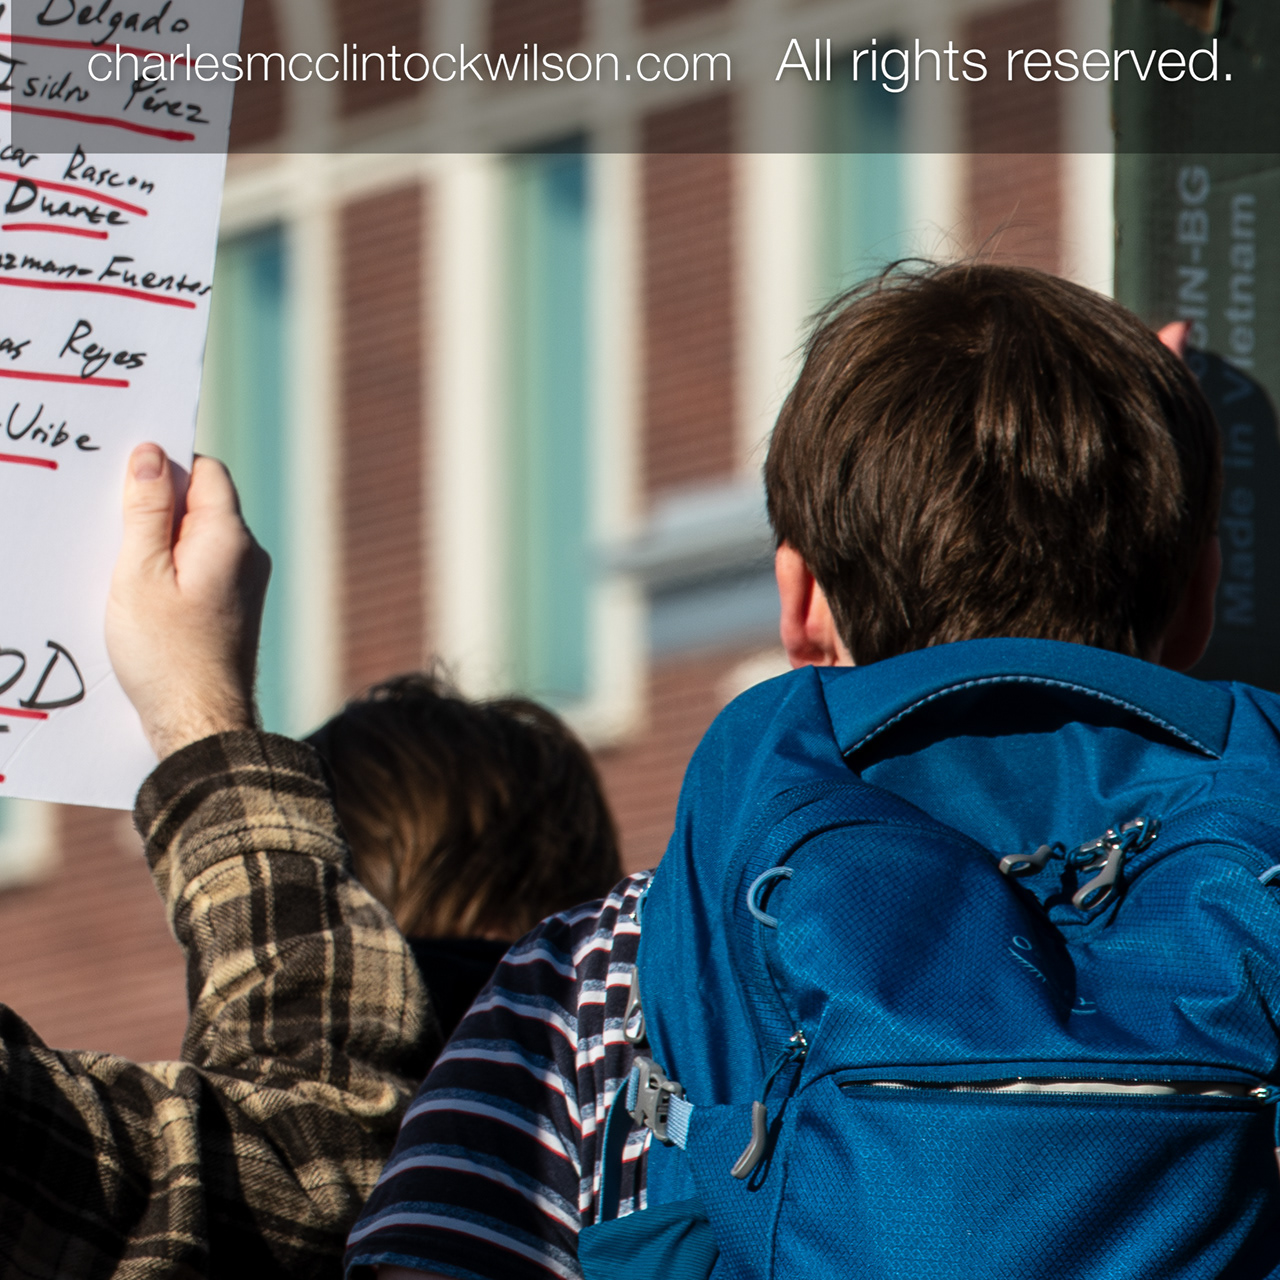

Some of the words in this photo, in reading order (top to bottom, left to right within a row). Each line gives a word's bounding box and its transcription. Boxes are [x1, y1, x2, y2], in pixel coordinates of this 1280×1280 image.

[63, 144, 156, 195] Rascon
[4, 178, 130, 226] Duarte
[1223, 193, 1257, 404] Vietnam
[59, 319, 148, 380] Reyes
